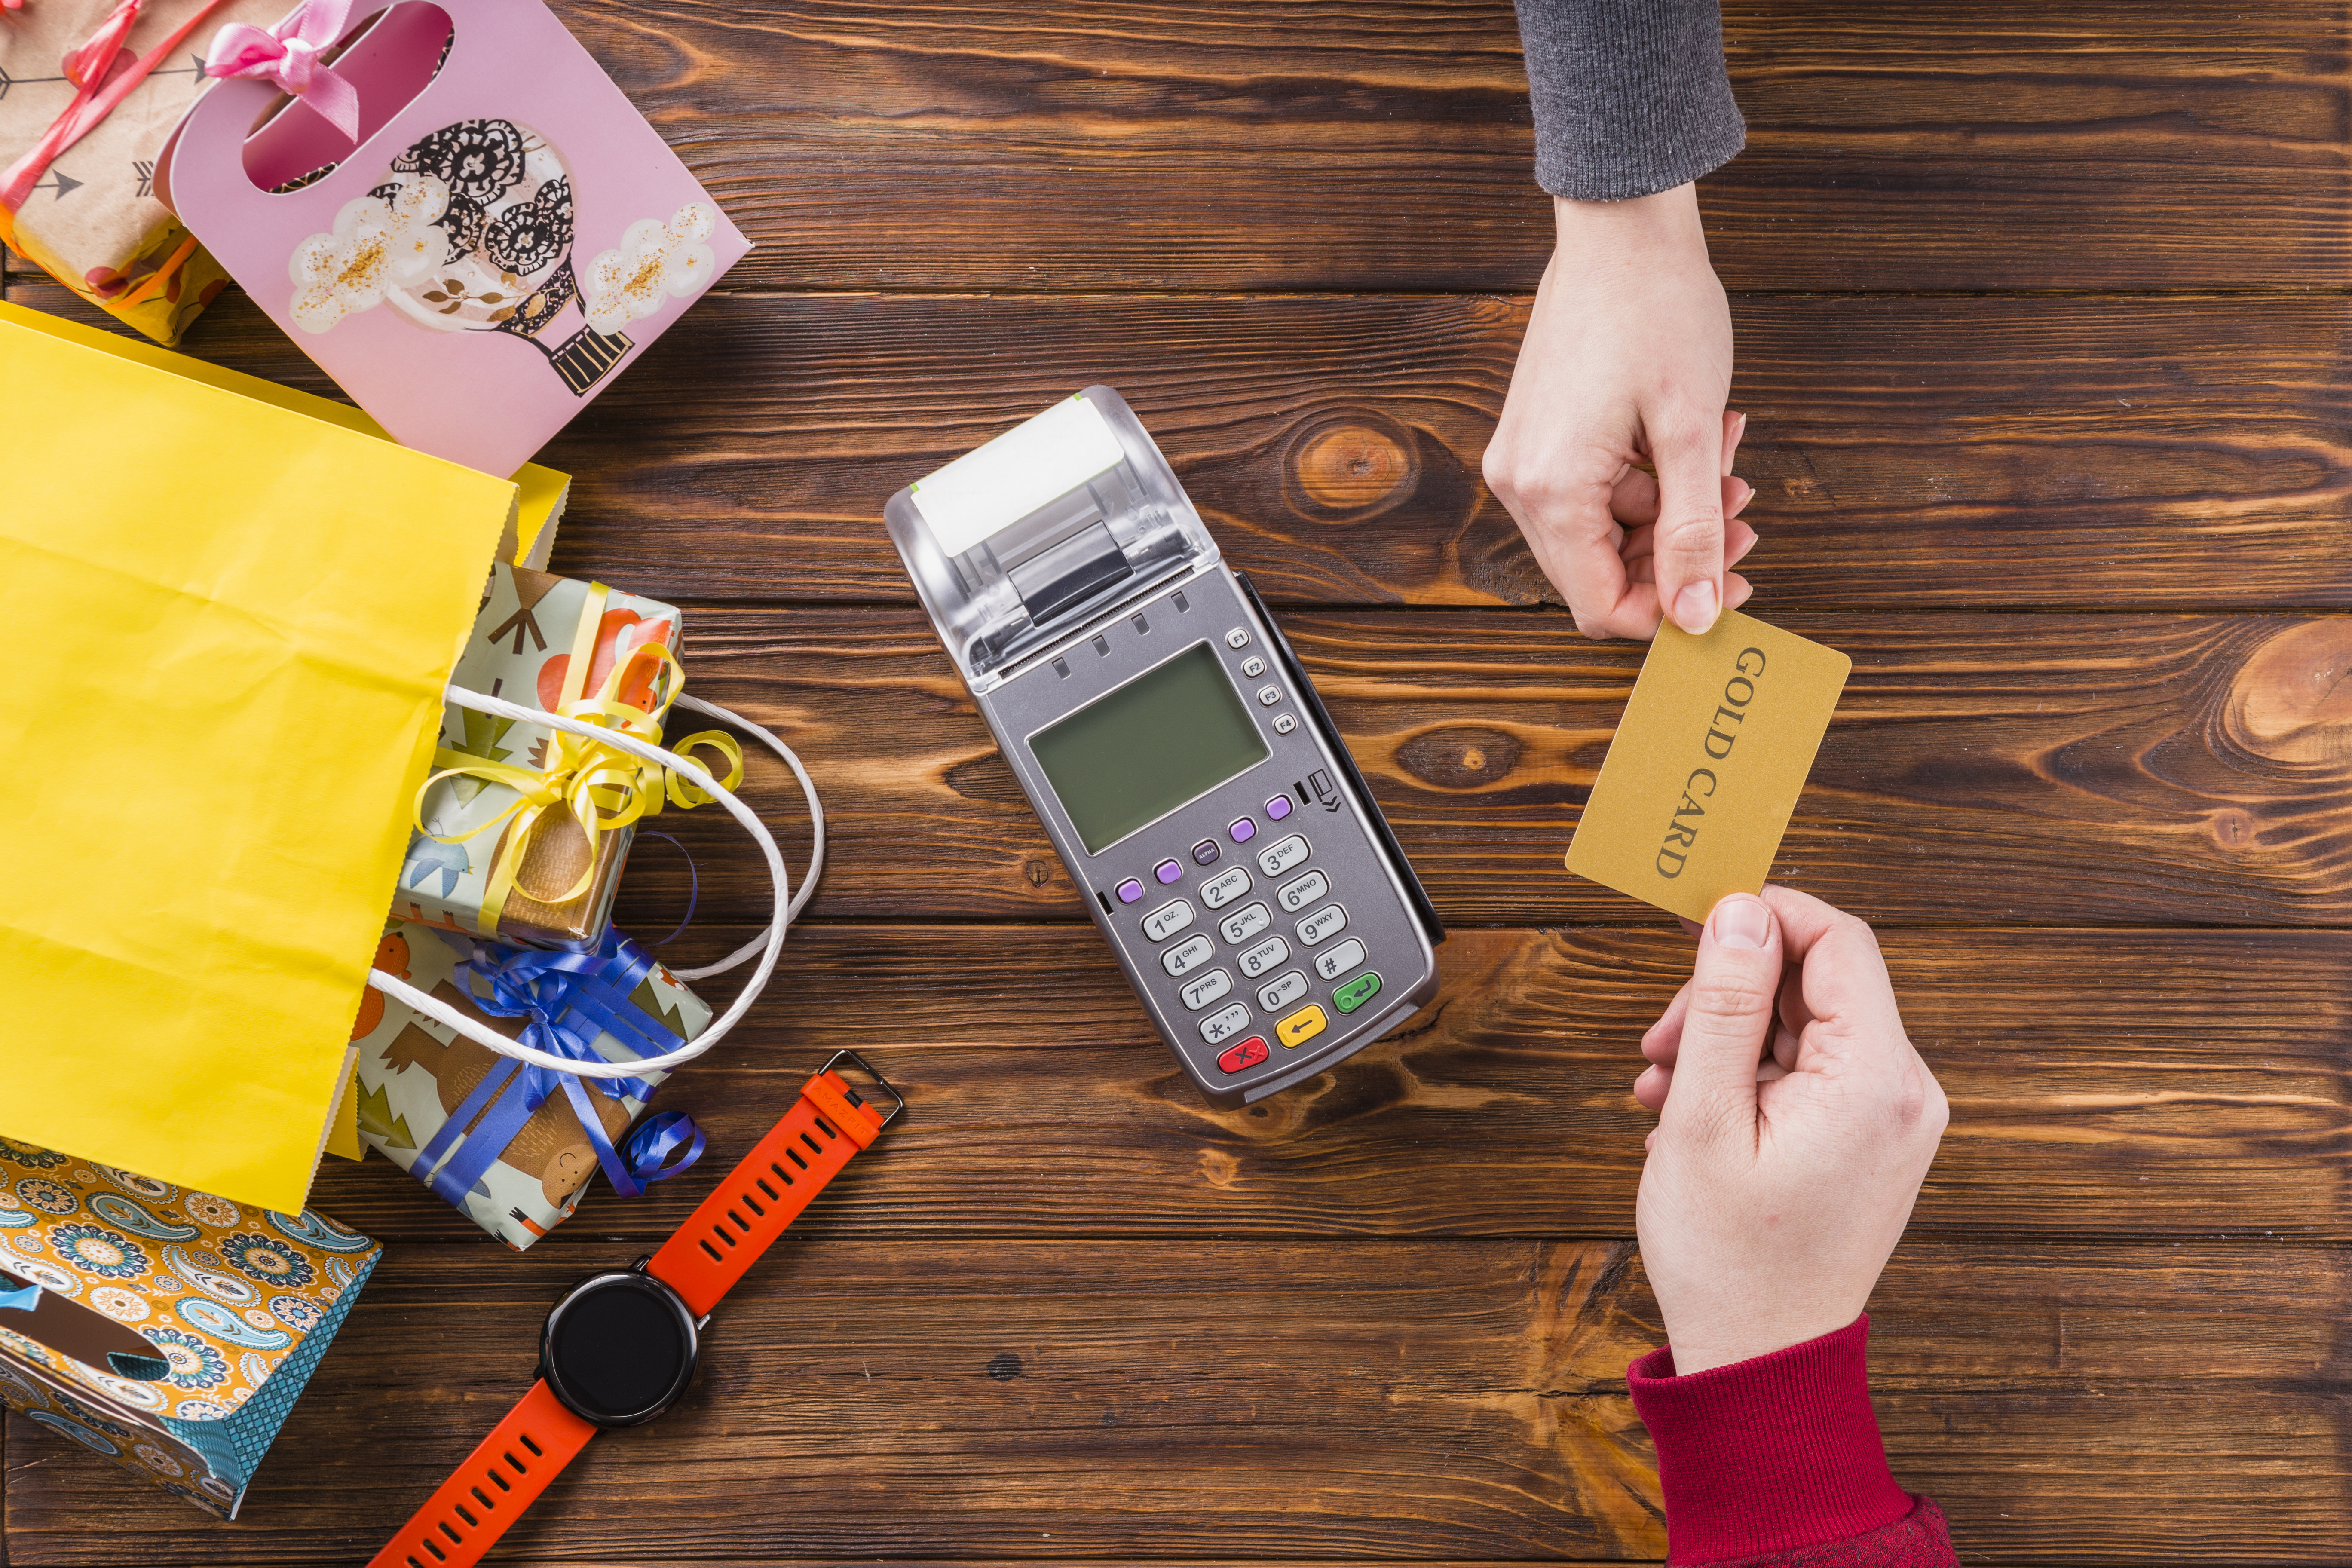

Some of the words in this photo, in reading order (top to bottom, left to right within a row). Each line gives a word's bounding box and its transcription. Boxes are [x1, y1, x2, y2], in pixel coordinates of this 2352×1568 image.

[1233, 634, 1244, 644] F1
[1249, 662, 1261, 673] F2
[1265, 691, 1277, 701] F3
[1705, 647, 1766, 760] GOLD
[1280, 720, 1291, 730] F4
[1656, 768, 1716, 879] CARD
[1199, 848, 1215, 859] ALPHA
[813, 1087, 868, 1136] AMAZFIT
